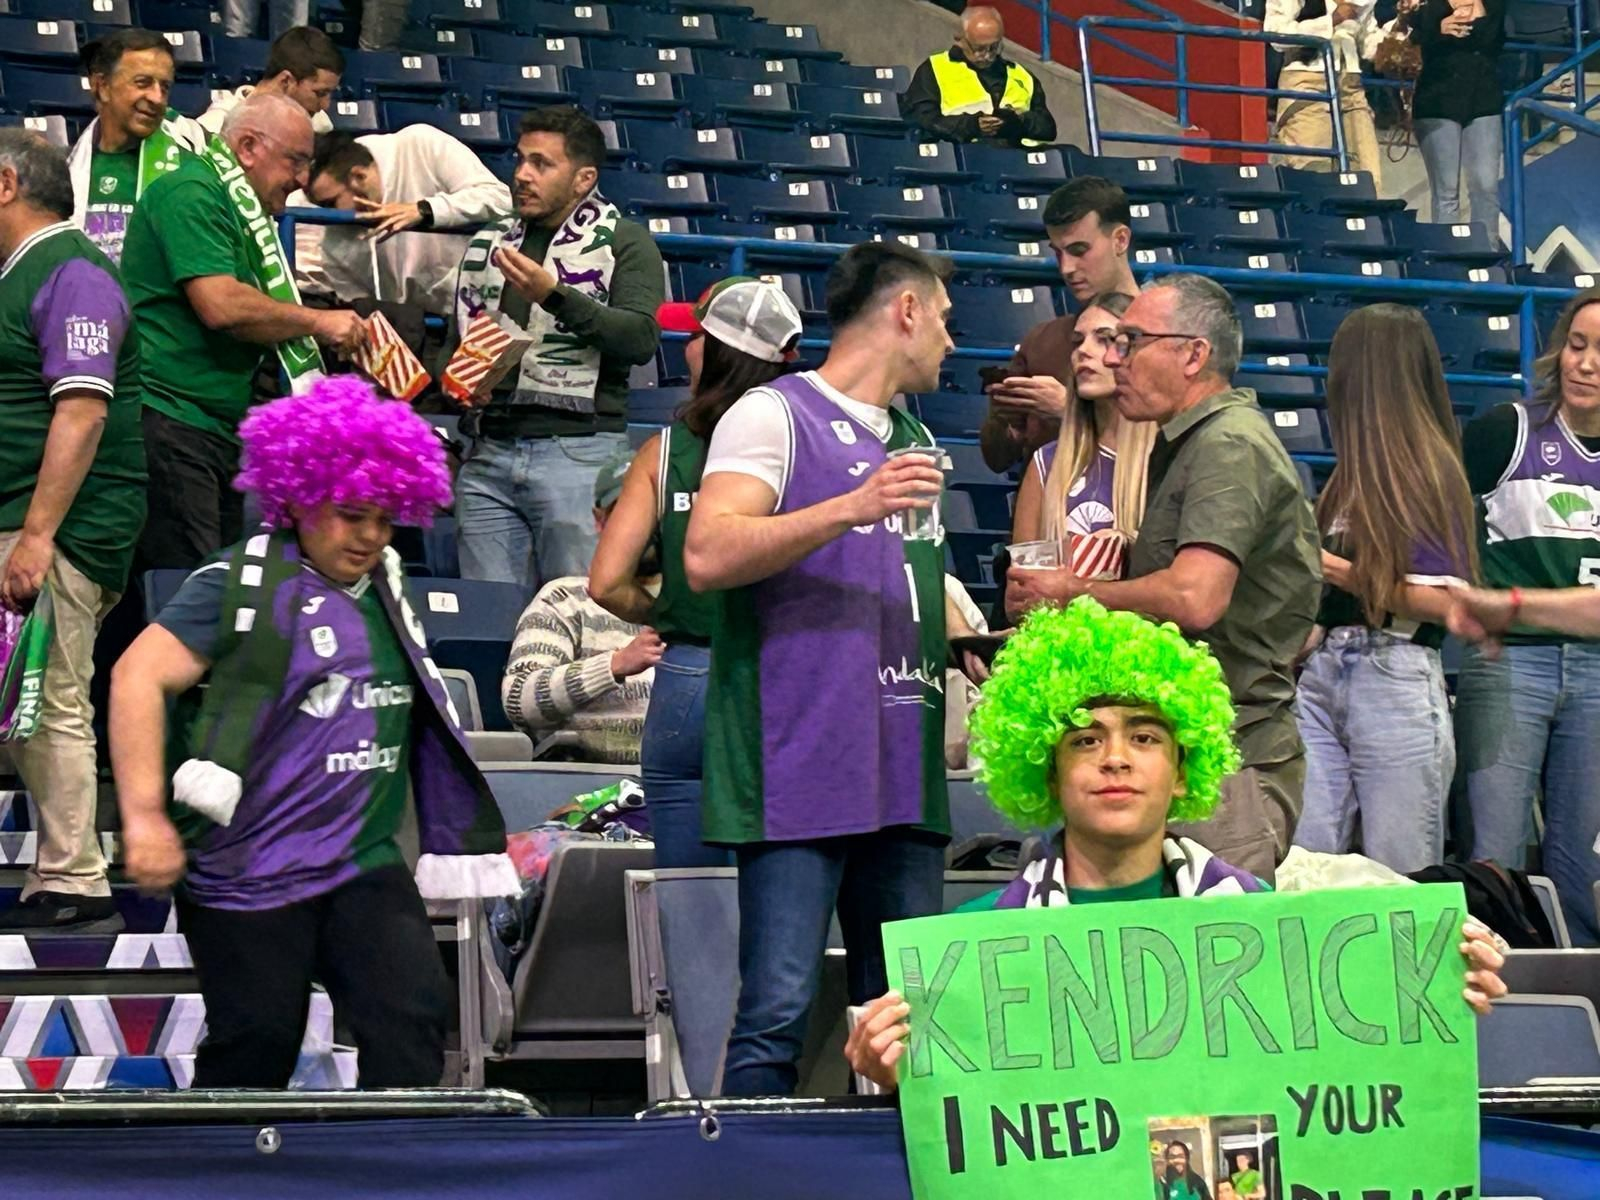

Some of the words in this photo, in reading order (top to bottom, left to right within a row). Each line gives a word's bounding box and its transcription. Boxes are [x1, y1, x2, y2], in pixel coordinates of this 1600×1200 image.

[899, 907, 1459, 1078] KENDRICK
[943, 1095, 966, 1175] I
[990, 1097, 1121, 1167] NEED
[1286, 1084, 1406, 1137] YOUR
